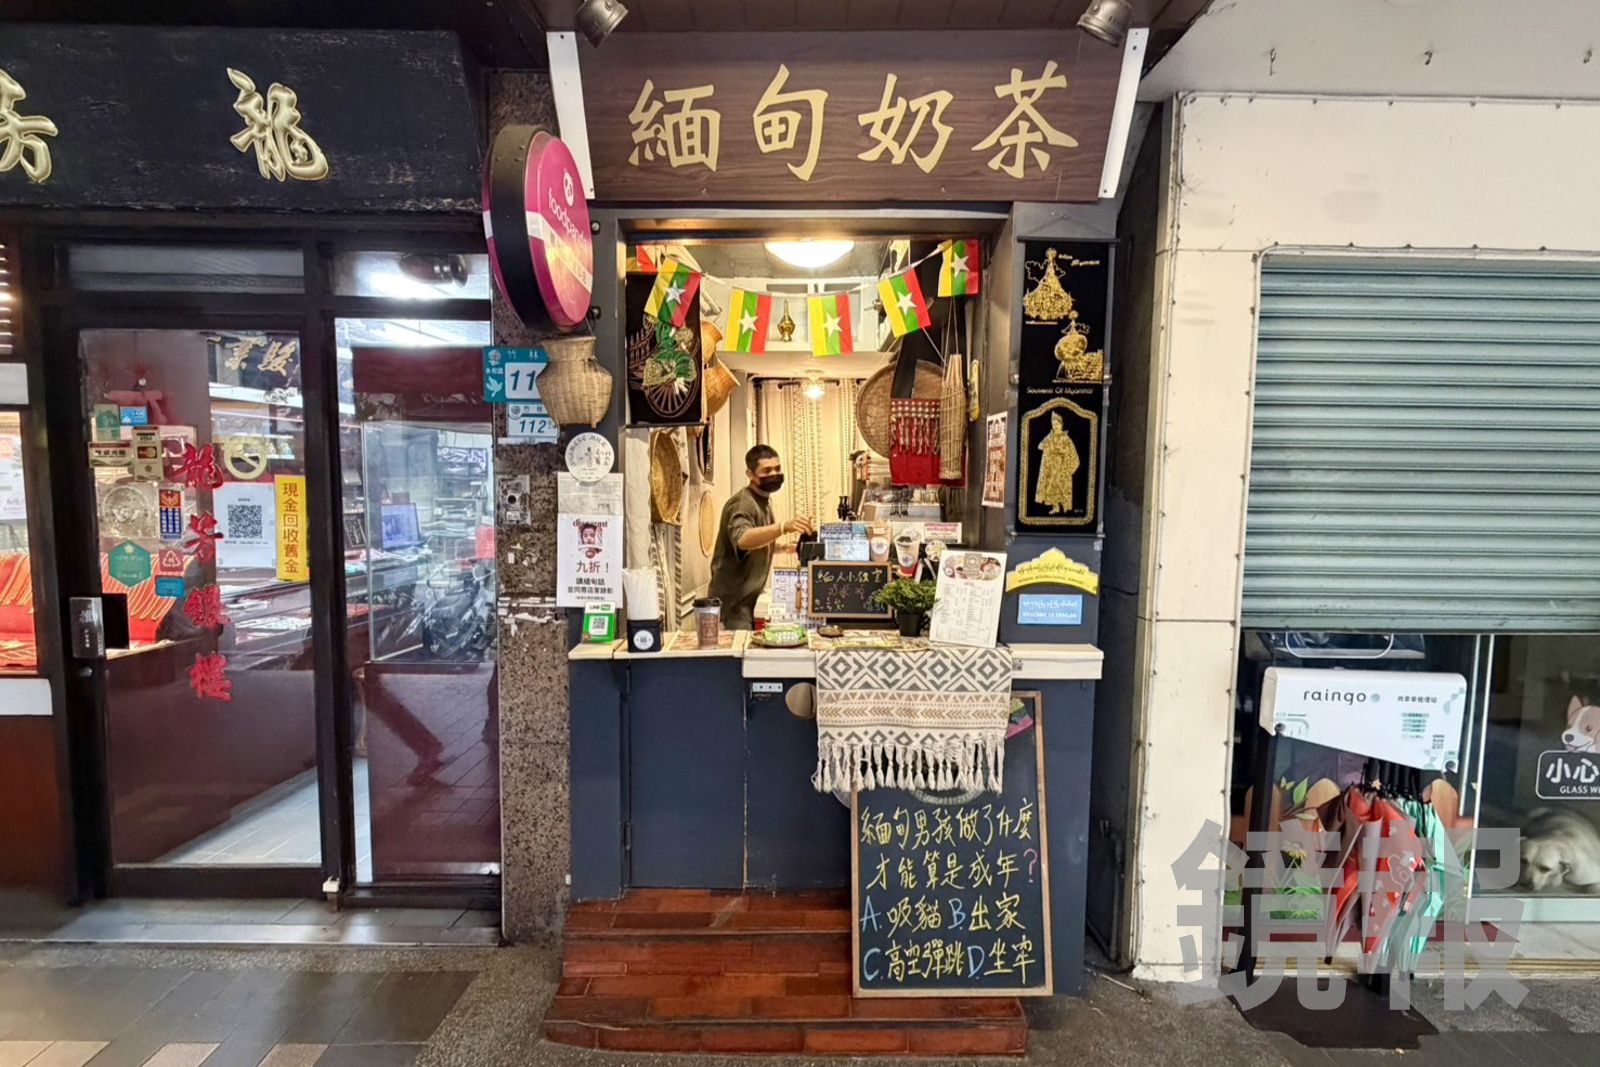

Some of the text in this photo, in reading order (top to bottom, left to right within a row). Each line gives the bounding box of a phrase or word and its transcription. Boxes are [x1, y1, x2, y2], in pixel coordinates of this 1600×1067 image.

[628, 60, 1079, 182] 緬甸奶茶
[548, 186, 589, 255] foodpanda
[1064, 386, 1094, 396] Myanmar
[520, 419, 547, 433] 112
[282, 482, 300, 574] 現金回收舊金
[1303, 689, 1367, 705] raingo
[1545, 758, 1600, 783] 小心
[1559, 785, 1588, 794] GLASS
